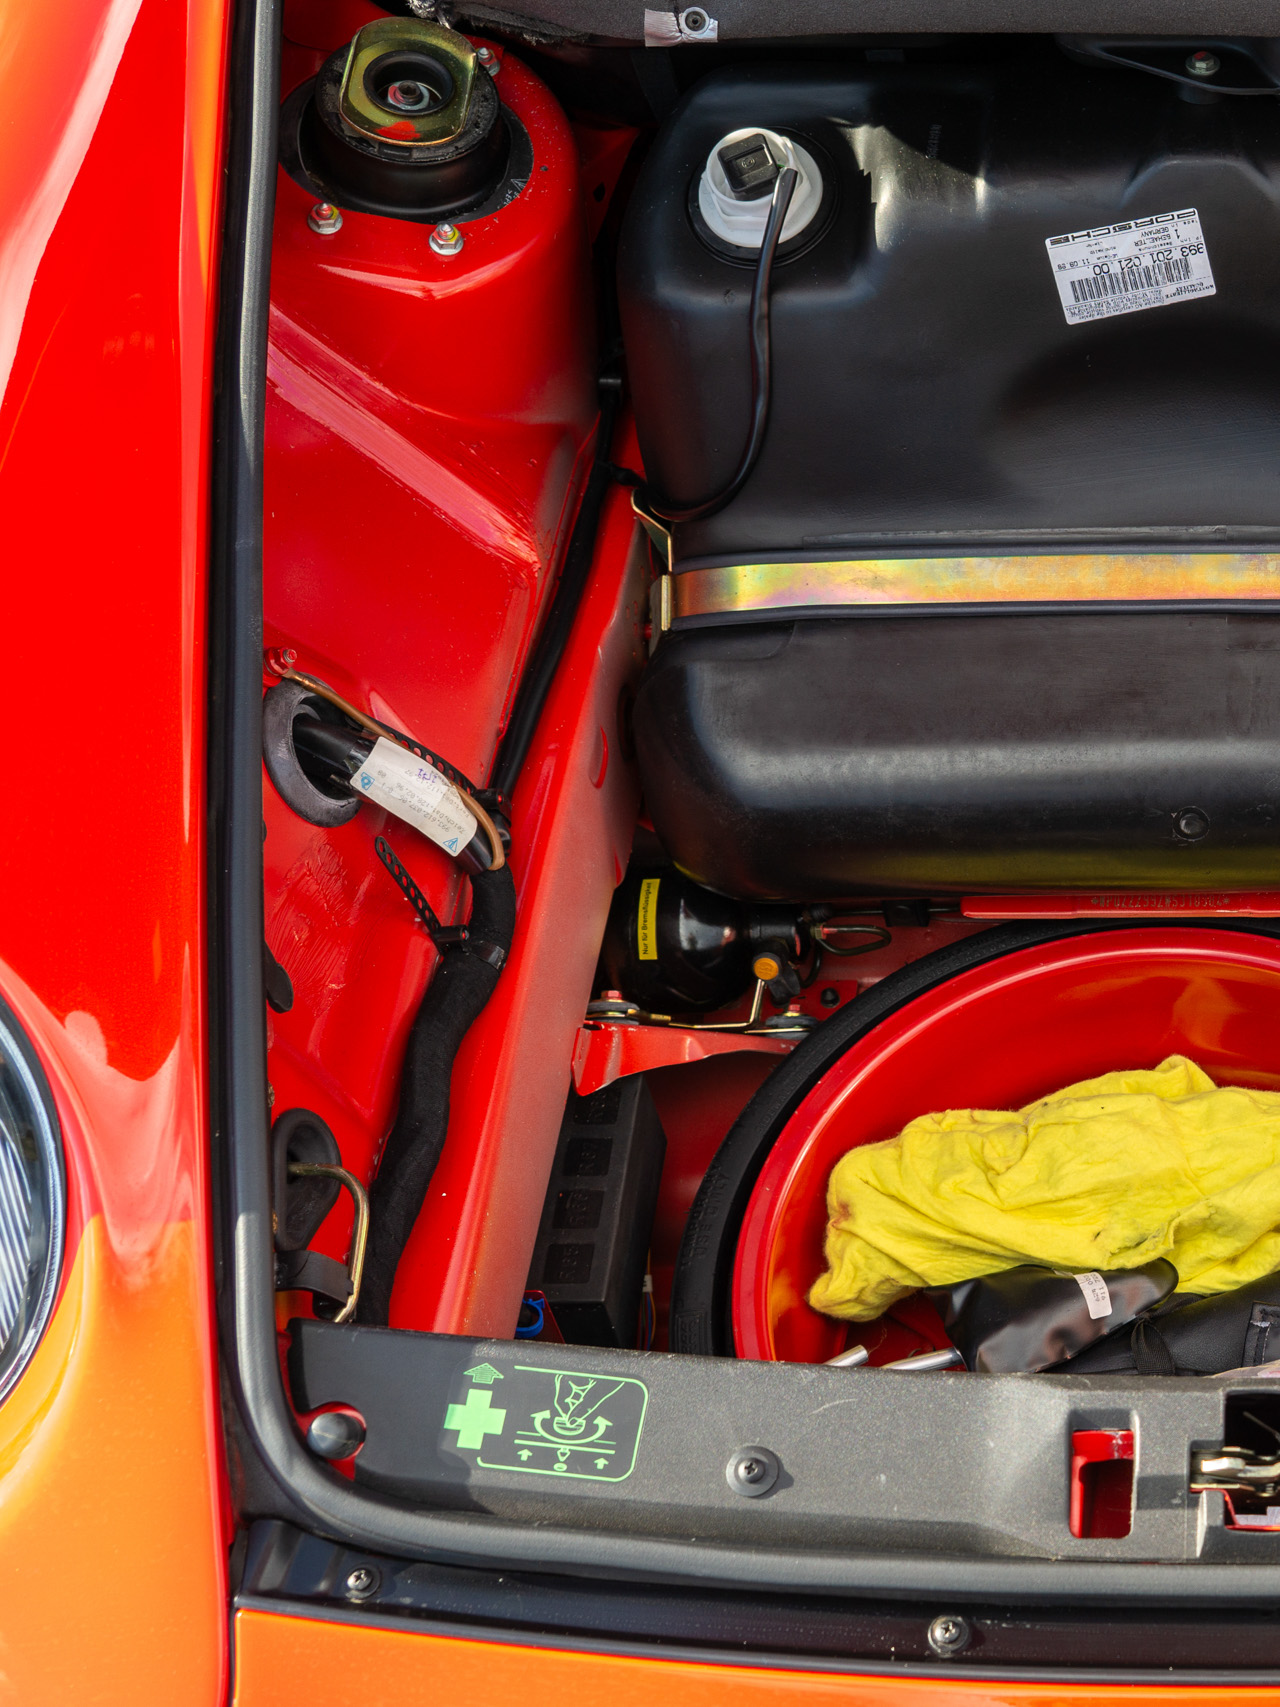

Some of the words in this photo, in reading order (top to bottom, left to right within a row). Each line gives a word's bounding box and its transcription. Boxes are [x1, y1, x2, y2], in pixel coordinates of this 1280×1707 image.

[1049, 209, 1196, 245] PORSCHE
[1139, 226, 1169, 237] GERMANY
[641, 882, 651, 930] Bremsflüssigkeit
